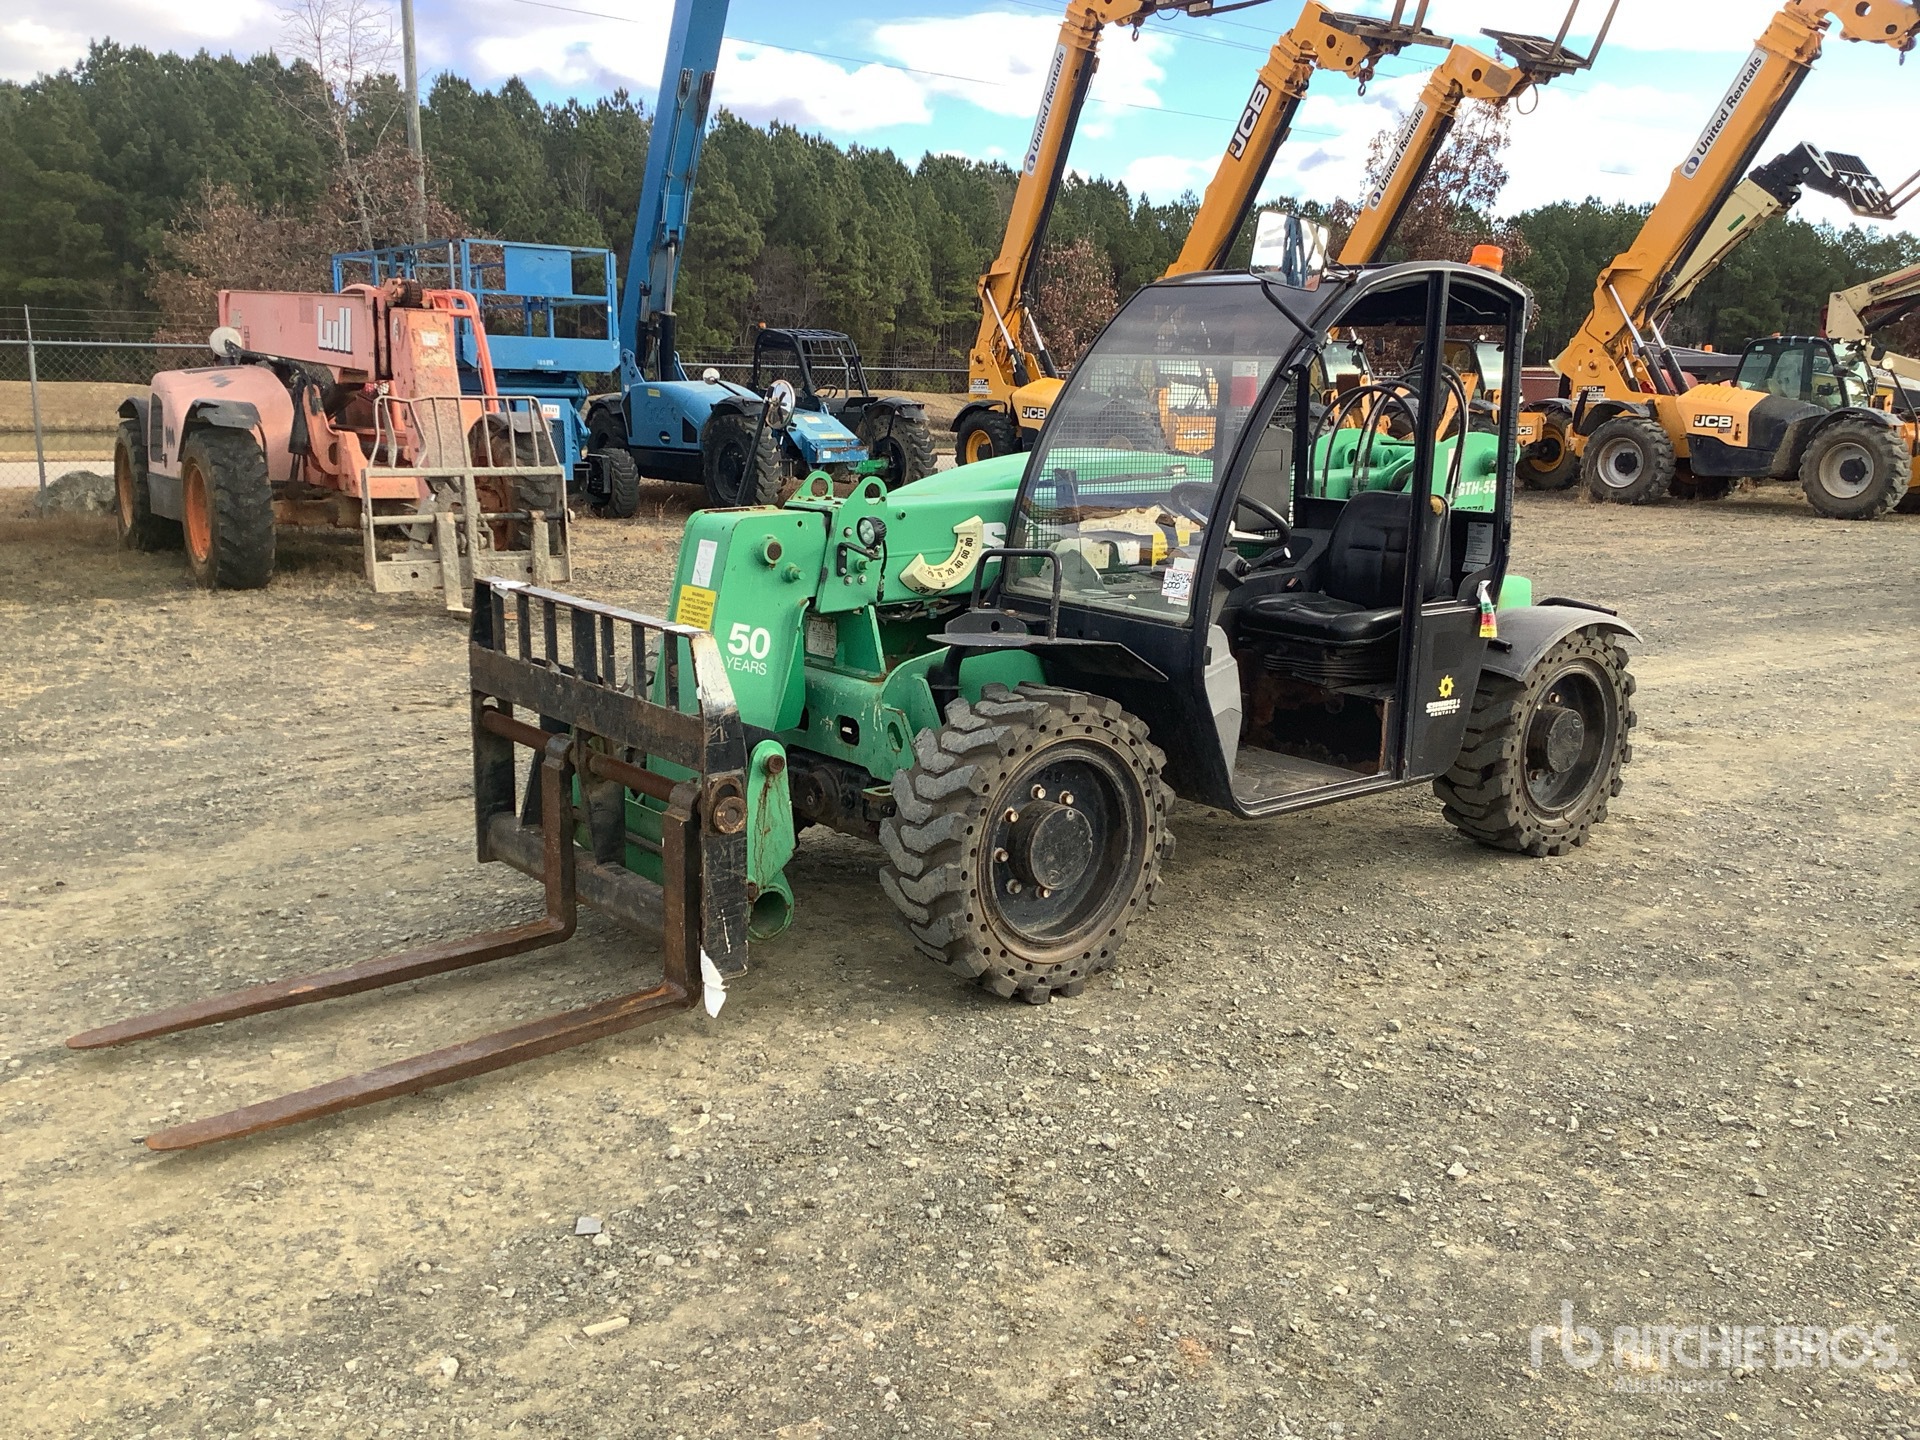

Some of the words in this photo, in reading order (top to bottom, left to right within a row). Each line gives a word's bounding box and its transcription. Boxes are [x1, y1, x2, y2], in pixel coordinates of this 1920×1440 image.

[1032, 105, 1049, 152] United
[1045, 51, 1064, 104] Rentals
[1696, 108, 1729, 156] United
[1725, 57, 1762, 109] Rentals
[1234, 83, 1270, 158] JCB
[1378, 152, 1402, 191] United
[1398, 108, 1424, 153] Rentals
[317, 304, 353, 354] Lull
[1022, 407, 1046, 419] JCB
[1694, 415, 1732, 428] JCB
[965, 537, 974, 547] 80
[954, 560, 964, 569] 40
[960, 549, 970, 560] 60
[945, 567, 955, 576] 20
[727, 622, 771, 660] 50
[725, 655, 767, 676] YEARS
